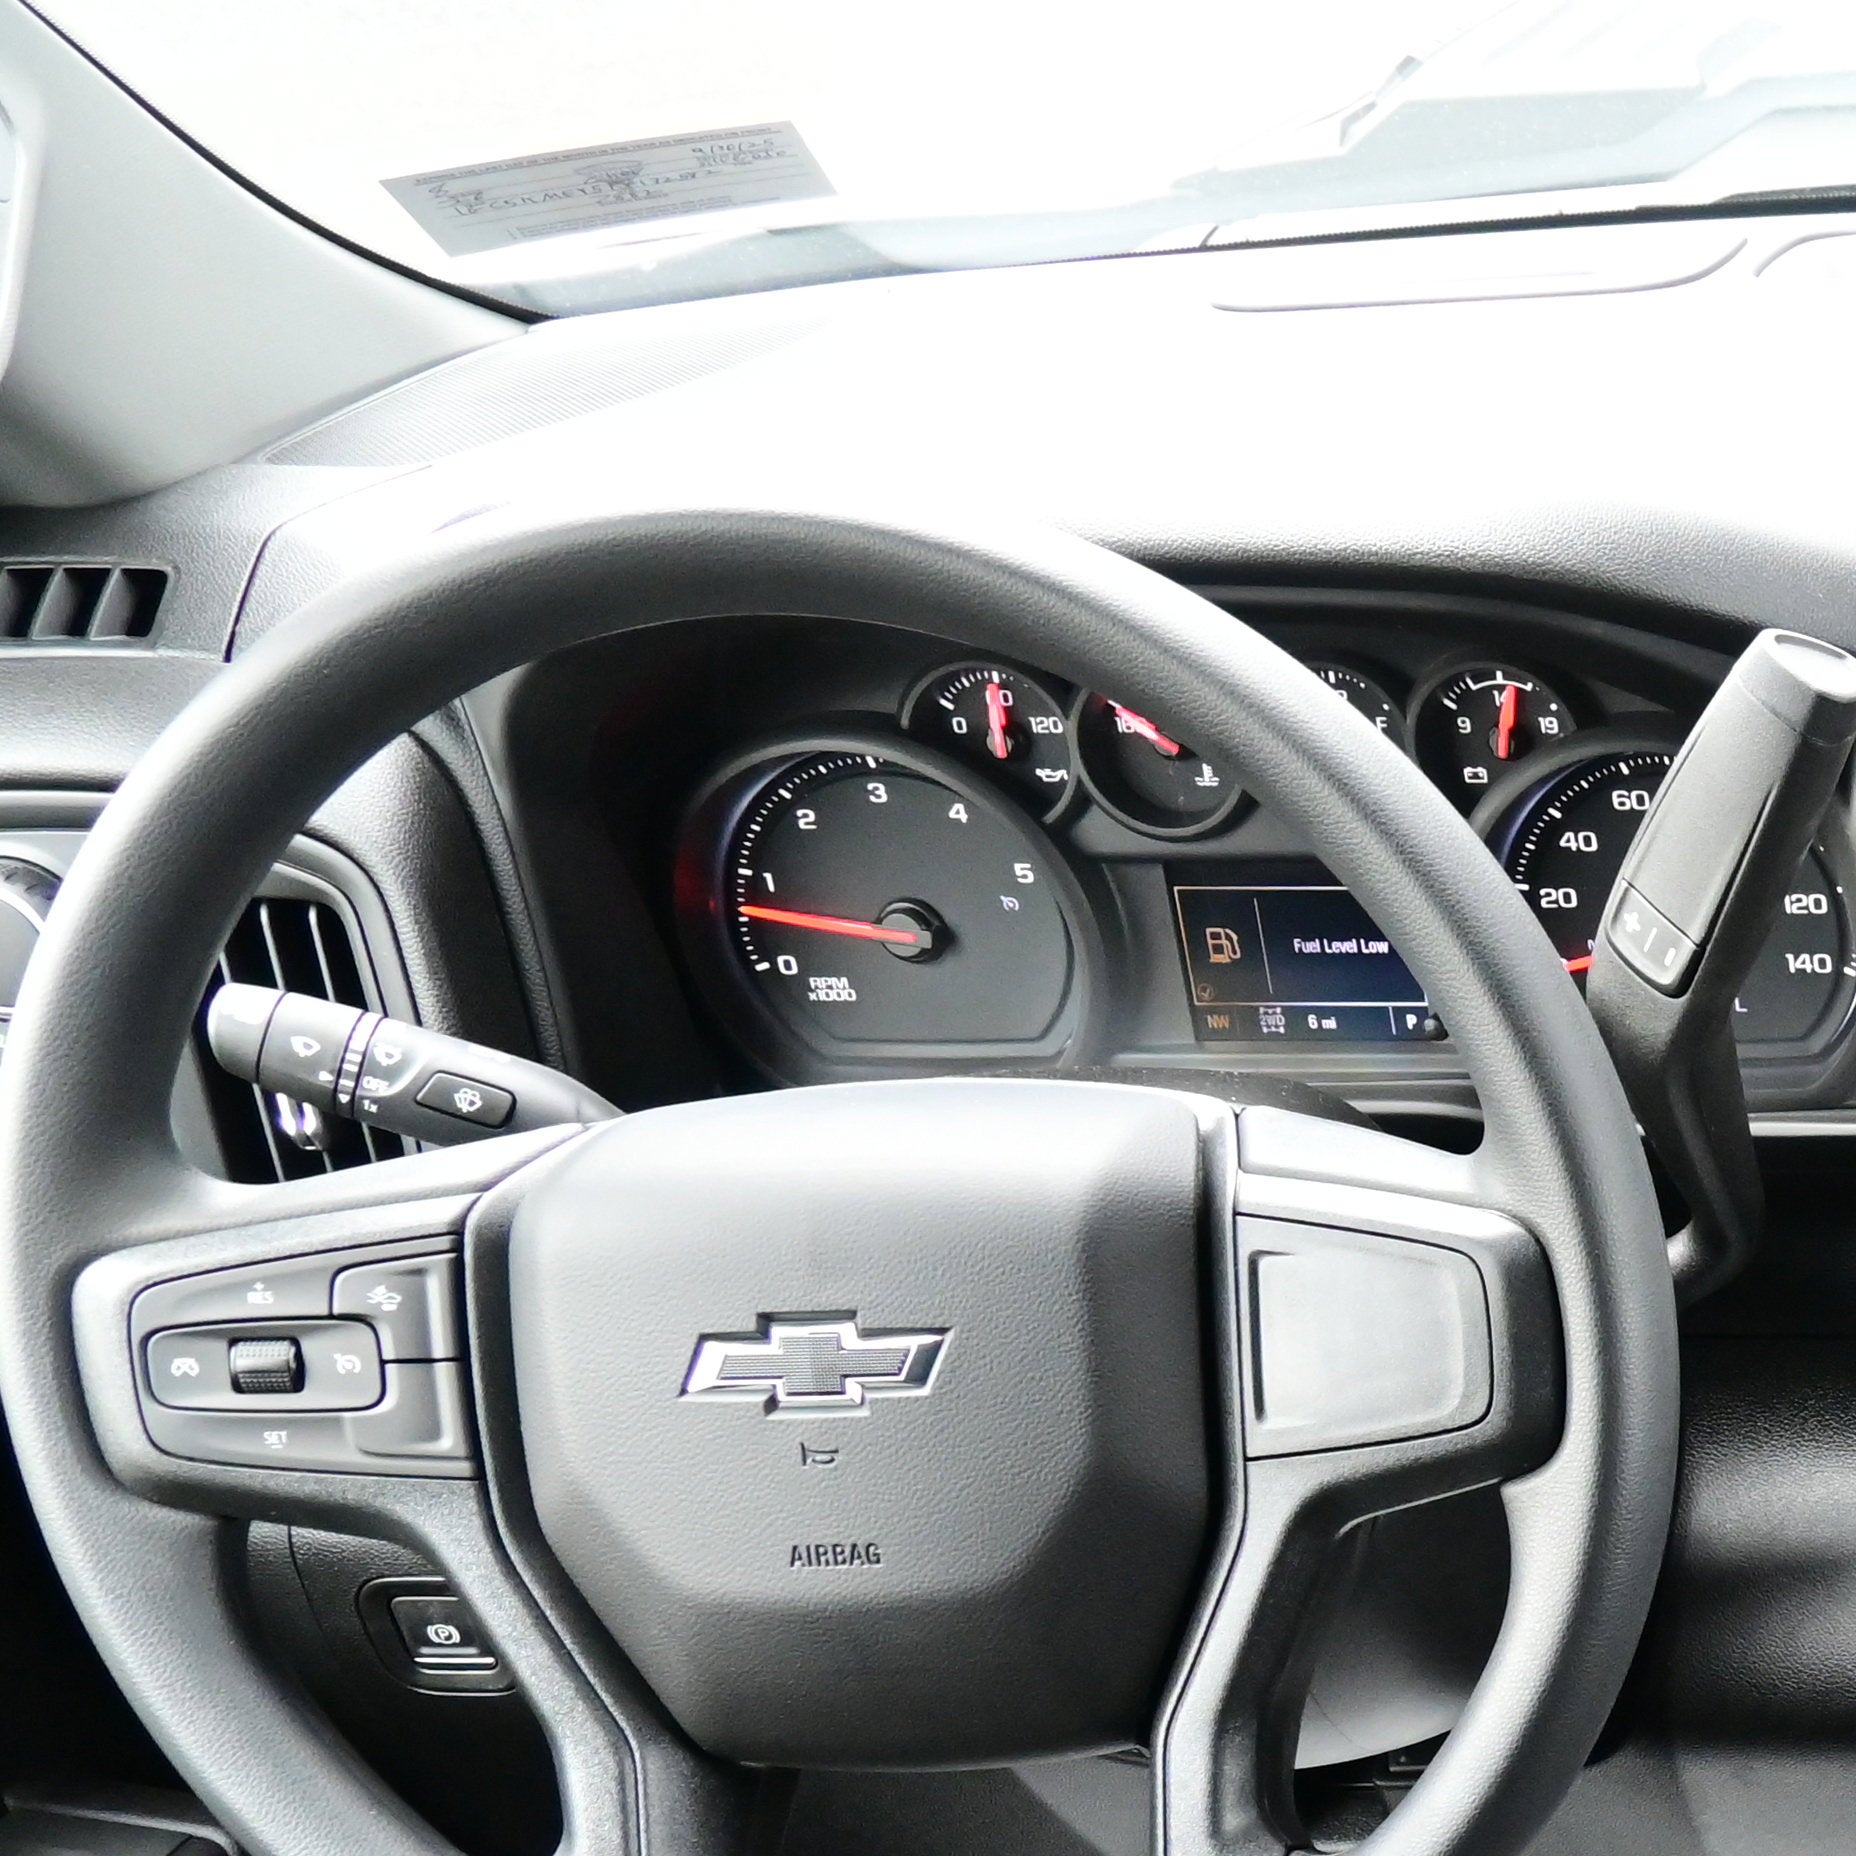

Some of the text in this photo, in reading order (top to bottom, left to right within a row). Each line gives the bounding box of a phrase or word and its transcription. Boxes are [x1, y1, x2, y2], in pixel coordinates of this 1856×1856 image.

[952, 717, 968, 735] 0
[1028, 716, 1065, 735] 120
[1456, 716, 1472, 734] 9
[1538, 717, 1559, 735] 19
[866, 782, 889, 804] 3
[1611, 790, 1650, 811] 60
[796, 809, 818, 831] 2
[947, 803, 970, 824] 4
[1559, 831, 1598, 853] 40
[761, 872, 776, 893] 1
[1013, 863, 1036, 885] 5
[1539, 887, 1578, 909] 20
[1783, 893, 1829, 915] 120
[1293, 938, 1390, 955] Fuel Level Low
[775, 955, 799, 976] 0
[1784, 953, 1833, 975] 140
[808, 976, 850, 990] RPM
[808, 988, 857, 1002] x1000
[1207, 1014, 1230, 1030] NW
[1259, 1014, 1286, 1028] 2WD
[1307, 1013, 1338, 1030] 6 mi
[1405, 1013, 1418, 1030] P
[362, 1074, 390, 1093] OFF
[264, 1430, 289, 1445] SET
[790, 1542, 883, 1569] AIRBAG
